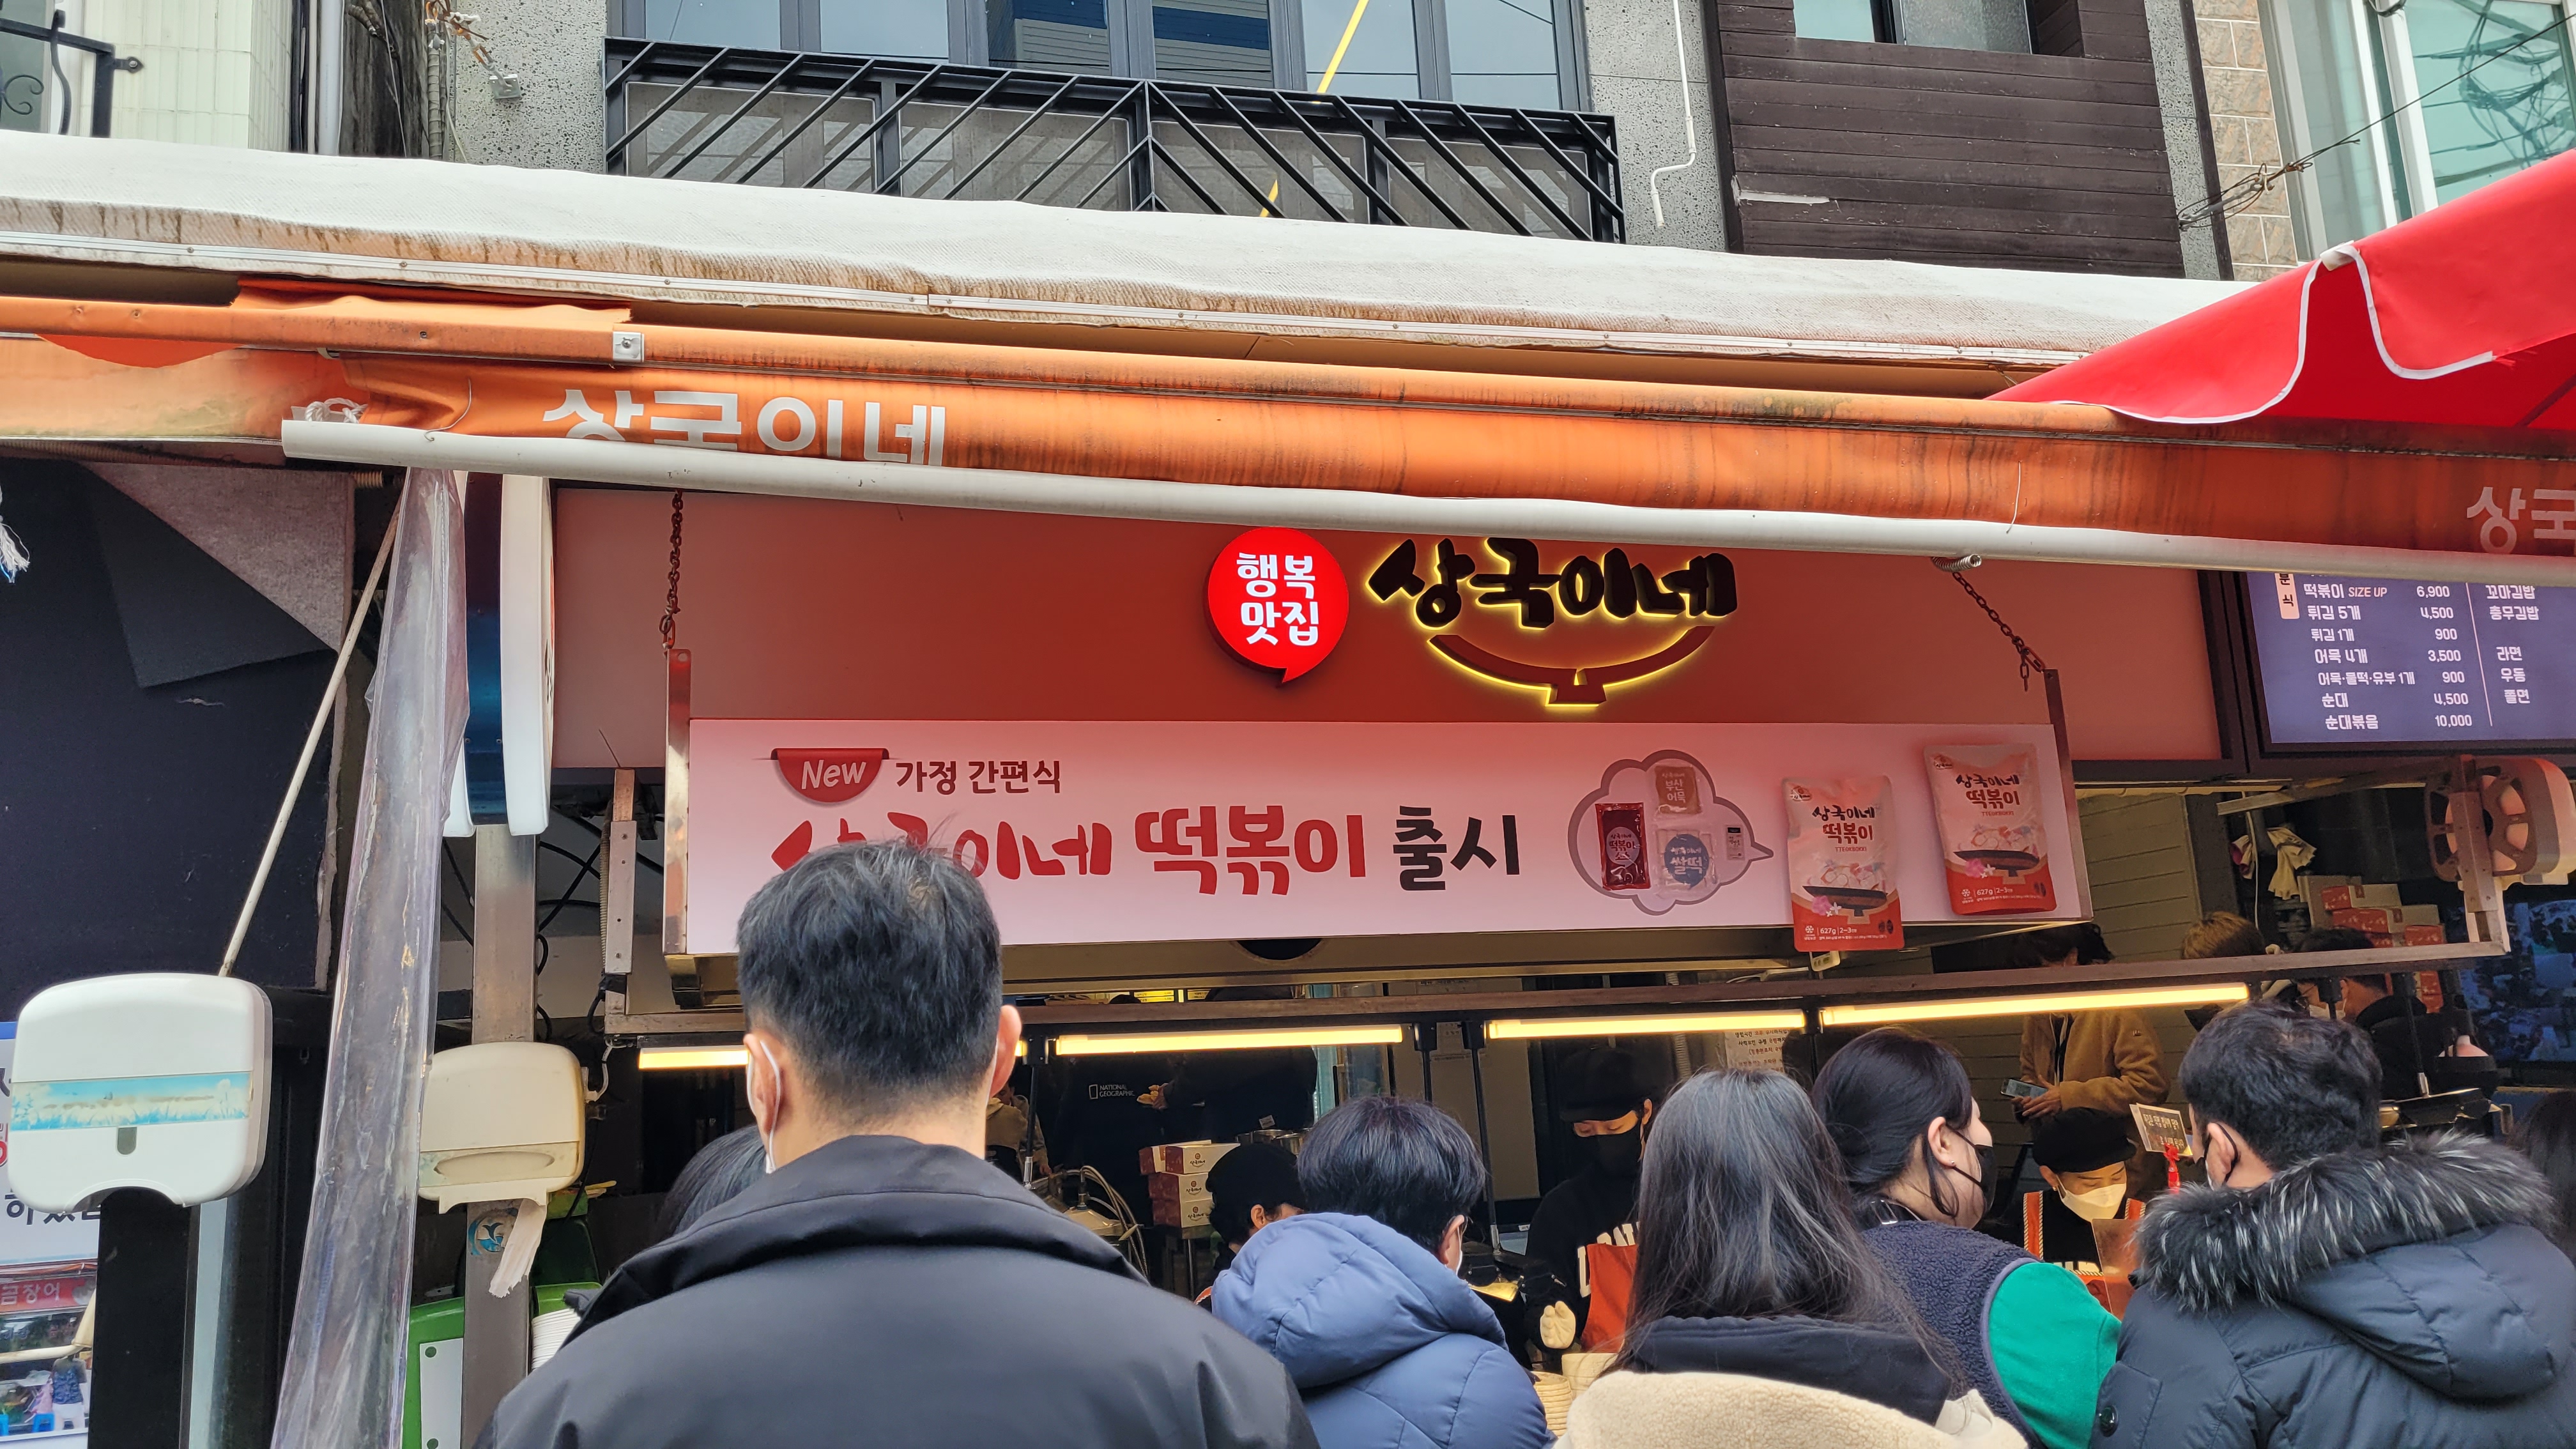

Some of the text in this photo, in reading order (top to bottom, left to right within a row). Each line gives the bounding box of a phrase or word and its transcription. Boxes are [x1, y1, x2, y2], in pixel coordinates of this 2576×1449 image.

[542, 388, 946, 466] 상국이네
[2467, 487, 2576, 555] 상국
[1237, 551, 1316, 598] 행복
[1367, 537, 1738, 629] 상국이네
[2303, 583, 2450, 599] 떡볶이 SIZE UP 6,900
[2485, 585, 2536, 599] 꼬마김밥
[2307, 605, 2454, 620] 튀김 5개 4,500
[2489, 605, 2540, 620] 충무김밥
[1240, 600, 1320, 647] 맛집
[2311, 628, 2458, 641] 튀김 1개 900
[2314, 648, 2462, 664] 어묵 4개 3,500
[2496, 646, 2523, 661] 라면
[2398, 671, 2416, 685] 1개
[2442, 671, 2465, 684] 900
[2501, 668, 2526, 682] 우동
[2321, 692, 2469, 708] 순대 4,500
[2325, 714, 2472, 730] 순대볶음 10,000
[801, 758, 868, 790] New
[895, 760, 1062, 795] 가정 간편식
[1955, 773, 2020, 789] 상국이네
[1666, 779, 1684, 792] 부산
[1667, 792, 1686, 804] 어묵
[1966, 788, 2020, 809] 떡볶이
[1812, 805, 1875, 822] 상국이네
[1823, 822, 1874, 845] 떡볶이
[1134, 805, 1367, 896] 떡볶이
[1393, 805, 1521, 891] 출시
[1609, 840, 1636, 852] 떡볶이
[1670, 856, 1703, 875] 쌀떡
[1820, 927, 1837, 935] 627g
